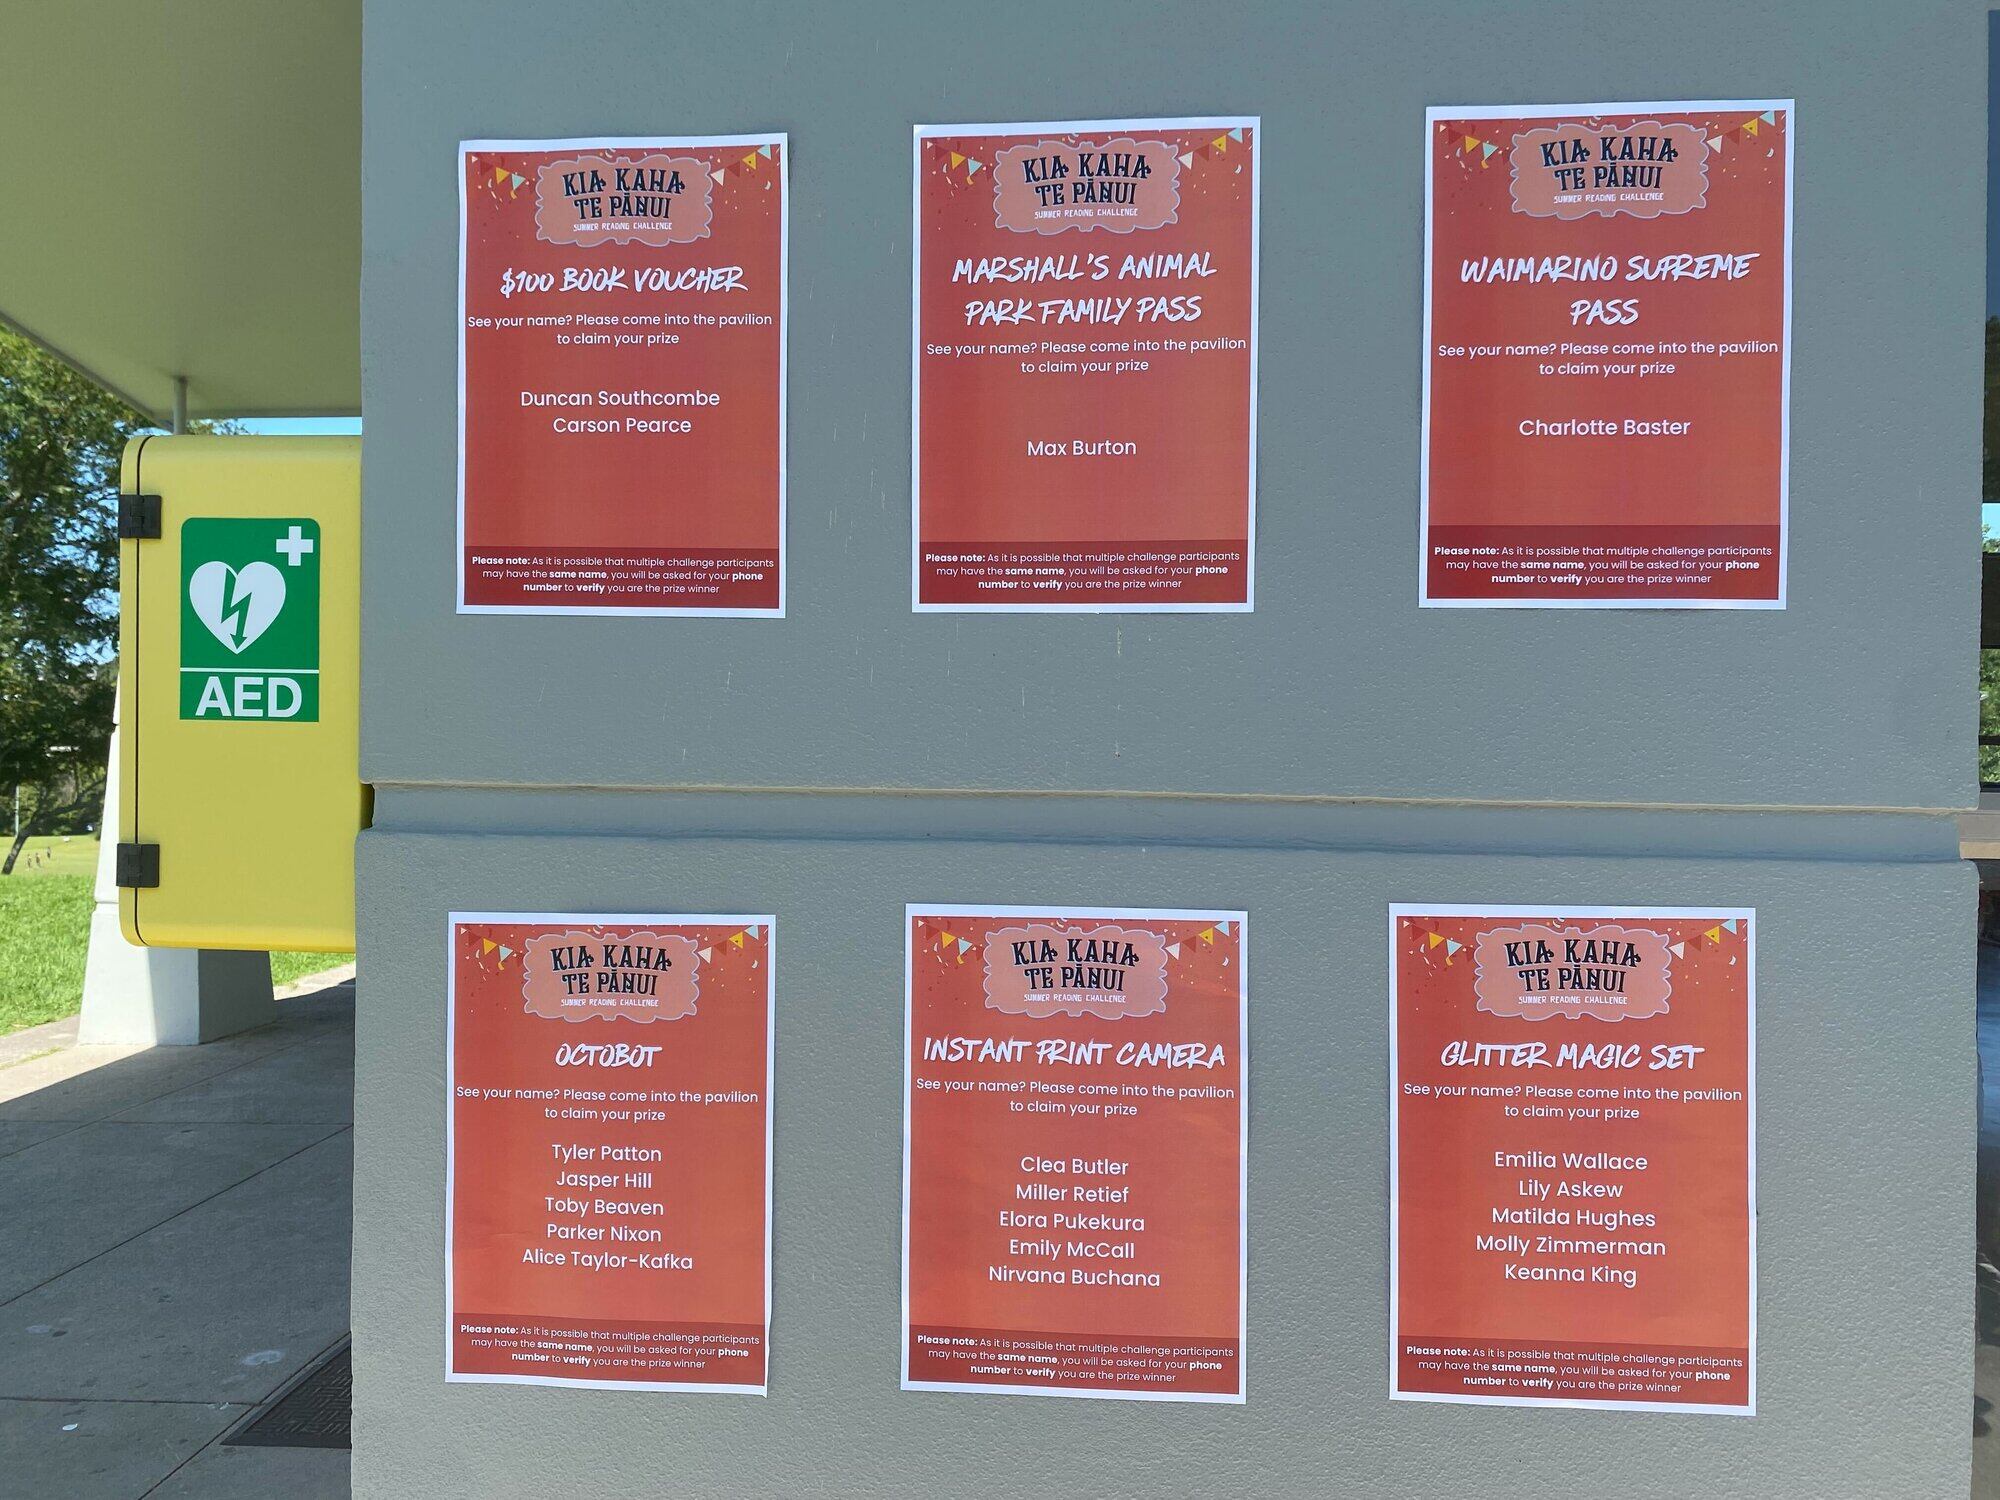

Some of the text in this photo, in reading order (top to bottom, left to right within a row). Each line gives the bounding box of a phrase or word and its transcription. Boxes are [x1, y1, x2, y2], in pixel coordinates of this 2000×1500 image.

[1540, 137, 1678, 167] KIA KAHA
[1023, 153, 1151, 184] KIA KAHA
[1554, 167, 1585, 190] TE
[563, 168, 685, 197] KIA KAHA
[1035, 184, 1064, 207] TE
[574, 197, 602, 220] TE
[952, 252, 1216, 284] MARSHALL'S ANIMAL
[1460, 252, 1759, 283] WAIMARINO SUPREME
[500, 266, 748, 298] $100 BOOK VOUCHER
[965, 296, 1201, 326] PARK FAMILY PASS
[1570, 299, 1639, 326] PASS
[927, 338, 1246, 358] See your name? Please come into the pavilion
[1021, 359, 1148, 375] to claim your prize
[522, 390, 720, 406] Duncan Southcombe
[554, 418, 691, 432] Carson Pearce
[1520, 419, 1690, 435] Charlotte Baster
[1028, 440, 1136, 455] Max Burton
[1435, 547, 1470, 555] Please
[1502, 547, 1514, 555] As
[1517, 547, 1523, 555] it
[1526, 547, 1534, 555] is
[1537, 547, 1579, 557] possible
[1582, 547, 1604, 555] that
[1607, 547, 1648, 557] multiple
[1652, 547, 1704, 557] challenge
[1708, 546, 1772, 557] participants
[1446, 562, 1470, 571] may
[1473, 560, 1498, 568] have
[1502, 560, 1518, 568] the
[1553, 562, 1586, 570] name,
[1589, 562, 1608, 571] you
[1630, 561, 1644, 569] be
[1647, 560, 1678, 569] asked
[1682, 560, 1696, 569] for
[1699, 562, 1722, 571] your
[1726, 560, 1759, 571] phone
[1492, 574, 1534, 582] number
[1538, 575, 1547, 583] to
[1550, 574, 1582, 585] verify
[1585, 576, 1604, 585] you
[1627, 575, 1644, 583] the
[1648, 574, 1672, 585] prize
[1676, 574, 1711, 582] winner
[195, 676, 302, 718] AED
[550, 945, 672, 973] KIA KAHA
[1012, 939, 1139, 967] KIA KAHA
[1504, 939, 1641, 967] KIA KAHA
[562, 973, 589, 995] TE
[1024, 967, 1053, 990] TE
[1519, 968, 1549, 991] TE
[1024, 994, 1126, 1003] SUMMER READING CHALLENGE
[555, 1043, 662, 1067] OCTOBOT
[923, 1036, 1225, 1069] INSTANT PRINT CAMERA
[1440, 1042, 1704, 1070] GLITTER MAGIC SET
[457, 1087, 758, 1105] See your name? Please come into the pavilion
[1404, 1084, 1741, 1103] See your name? Please come into the pavilion
[545, 1108, 665, 1123] to claim your prize
[1505, 1105, 1639, 1121] to claim your prize
[552, 1144, 661, 1164] Tyler Patton
[1496, 1151, 1647, 1170] Emilia Wallace
[1021, 1157, 1128, 1174] Clea Butler
[557, 1172, 651, 1191] Jasper Hill
[1520, 1179, 1623, 1201] Lily Askew
[1017, 1184, 1128, 1202] Miller Retief
[545, 1197, 663, 1217] Toby Beaven
[1000, 1211, 1144, 1230] Elora Pukekura
[1493, 1208, 1655, 1230] Matilda Hughes
[548, 1224, 661, 1241] Parker Nixon
[1010, 1239, 1134, 1260] Emily McCall
[1477, 1236, 1665, 1256] Molly Zimmerman
[523, 1248, 692, 1271] Alice Taylor-Kafka
[990, 1265, 1160, 1286] Nirvana Buchana
[1506, 1264, 1636, 1288] Keanna King
